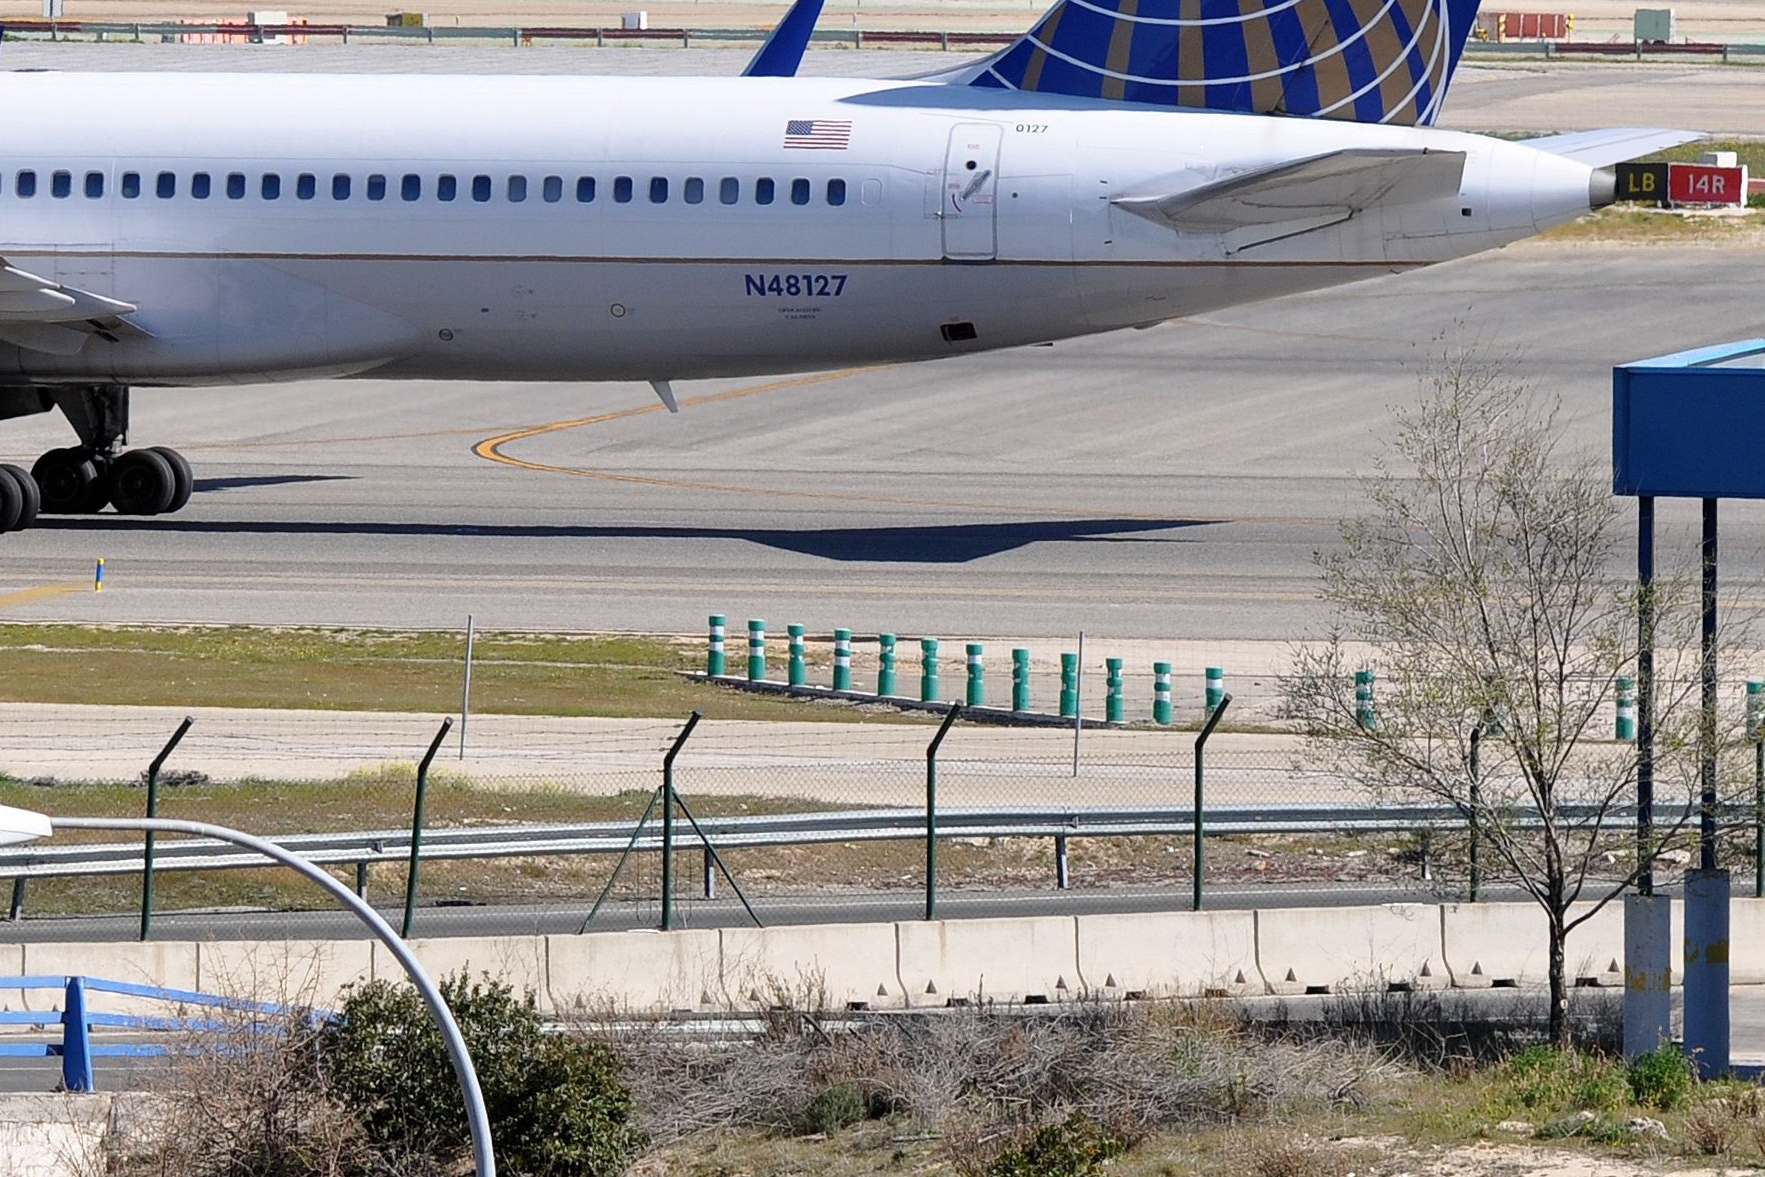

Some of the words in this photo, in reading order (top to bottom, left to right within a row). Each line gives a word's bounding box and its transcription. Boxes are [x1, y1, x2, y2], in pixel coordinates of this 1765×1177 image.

[1015, 124, 1049, 133] 0127
[1628, 172, 1655, 193] LB
[1688, 173, 1725, 195] 14R
[745, 274, 848, 297] N48127
